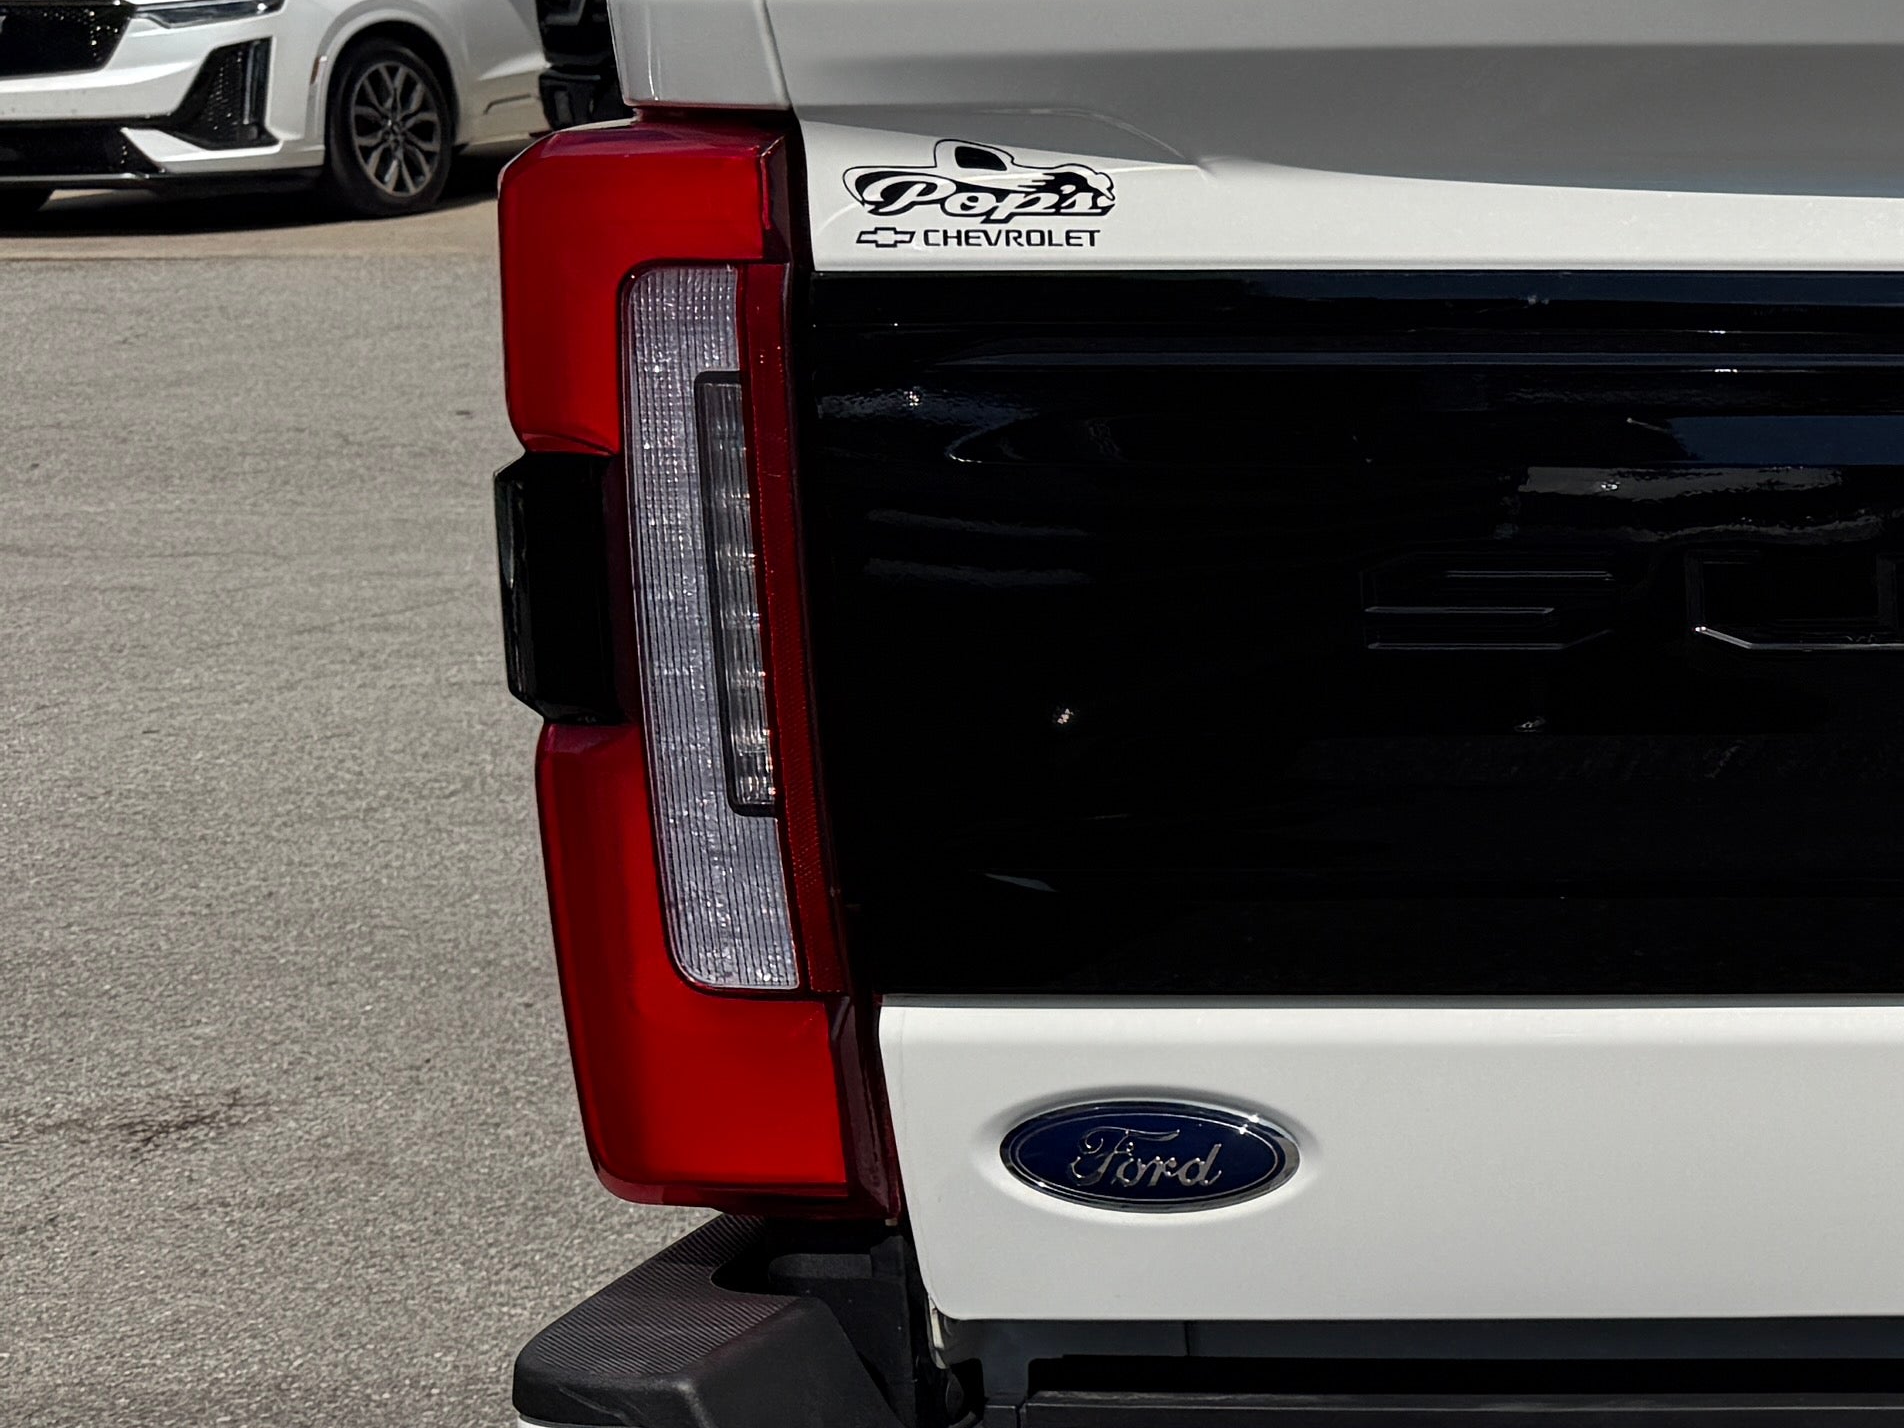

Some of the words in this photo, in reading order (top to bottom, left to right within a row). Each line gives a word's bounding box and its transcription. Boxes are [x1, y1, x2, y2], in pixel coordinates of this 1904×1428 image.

[858, 171, 1114, 224] Pop's
[923, 228, 1102, 248] CHEVROLET
[1067, 1125, 1223, 1188] Ford
